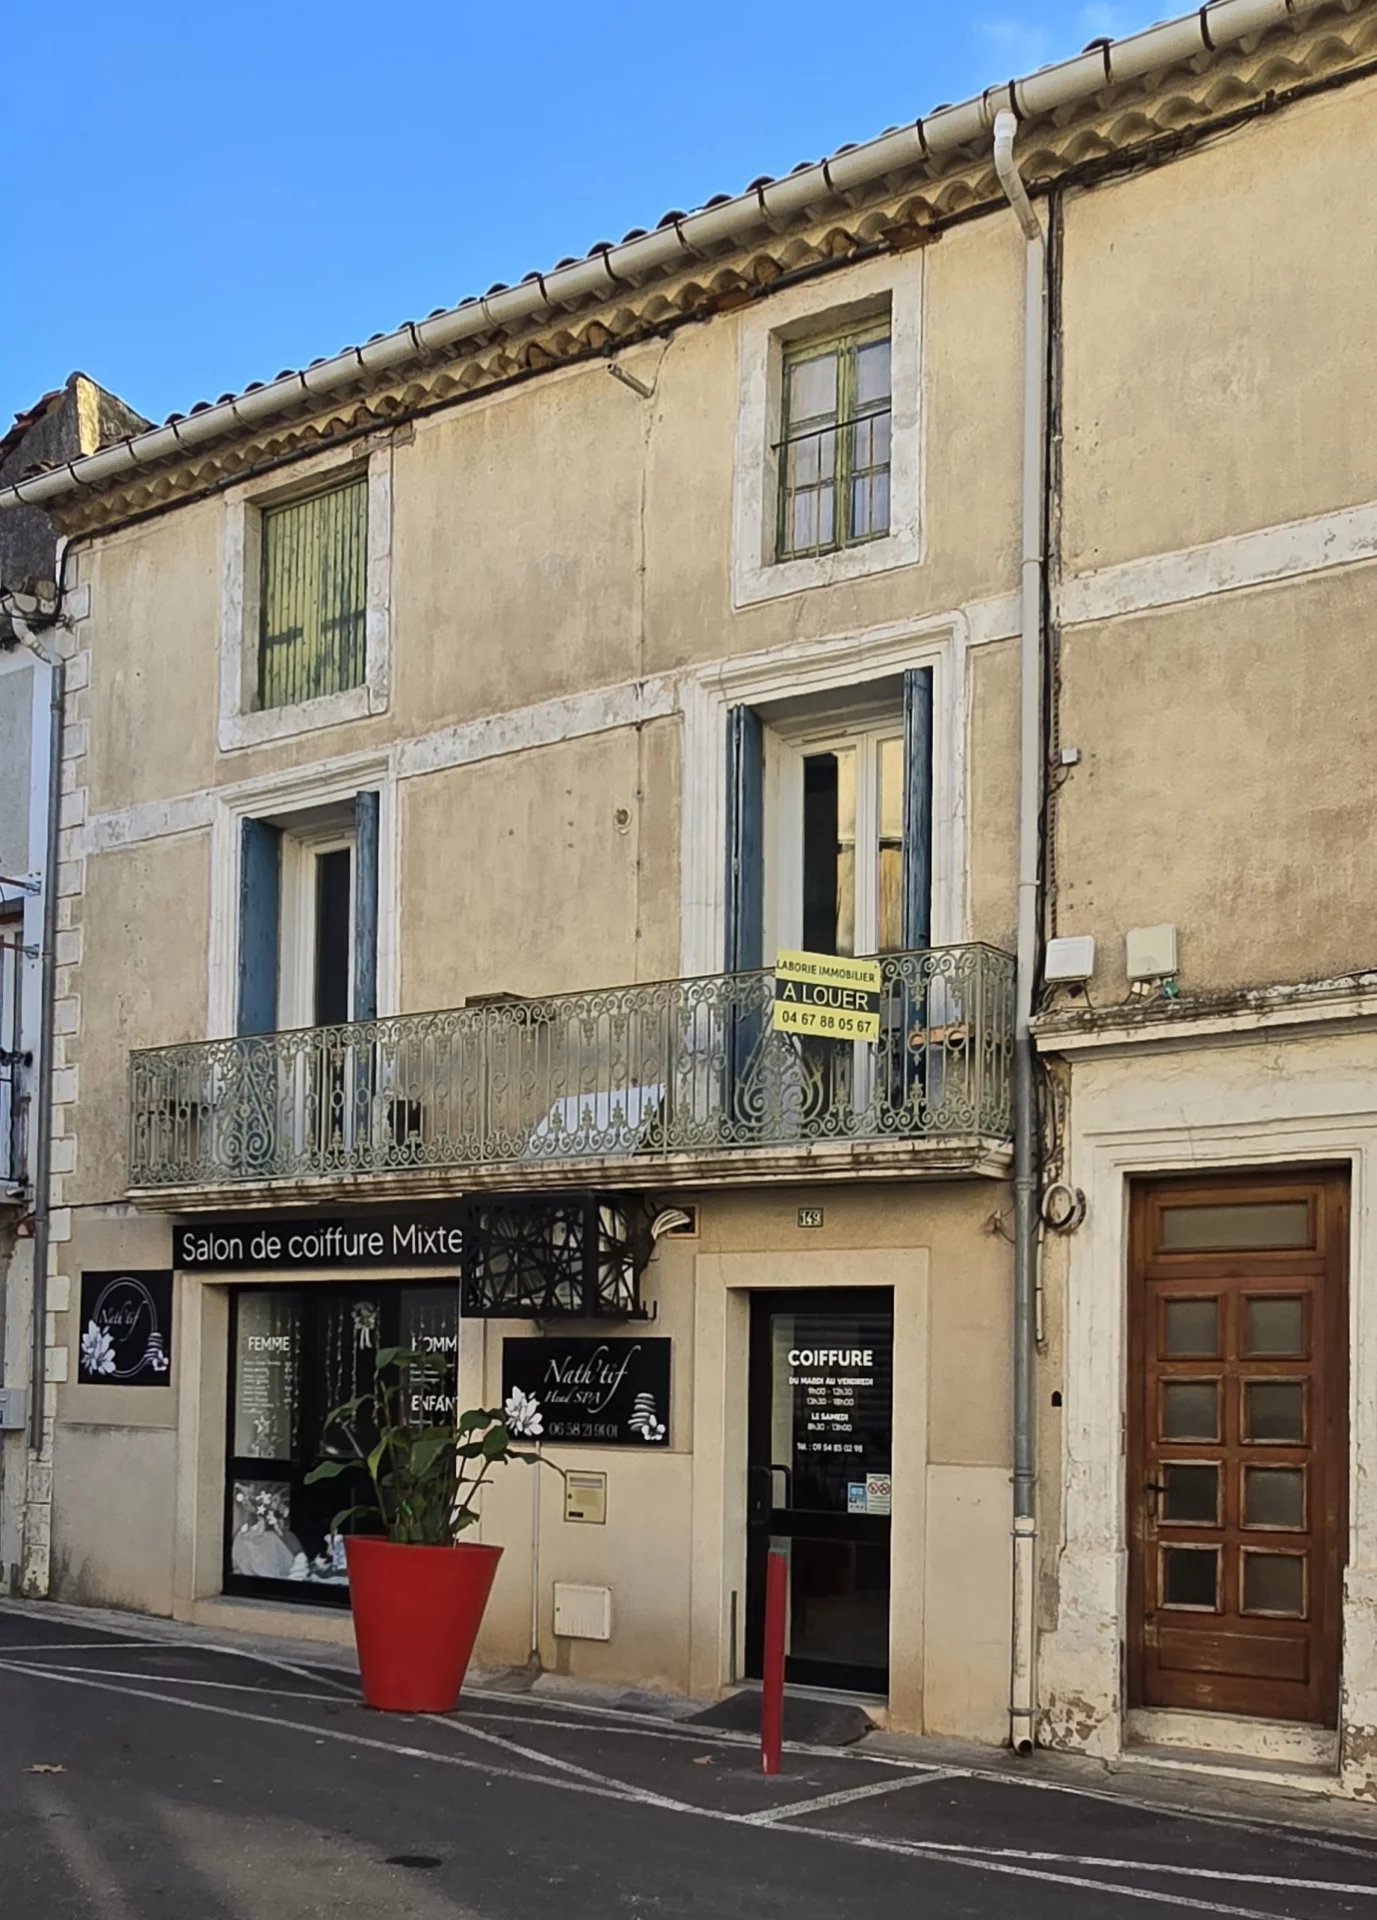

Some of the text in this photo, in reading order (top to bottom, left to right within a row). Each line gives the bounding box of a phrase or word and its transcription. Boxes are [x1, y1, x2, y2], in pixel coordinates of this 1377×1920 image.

[777, 960, 875, 982] LABORIE IMMOBILIER
[783, 982, 869, 1010] A LOUER
[782, 1010, 871, 1033] 04 67 88 05 67
[800, 1210, 821, 1225] 149
[182, 1224, 463, 1261] Salon de coiffure Mixte
[248, 1336, 290, 1351] FEMME
[788, 1350, 873, 1366] COIFFURE
[544, 1345, 641, 1414] Nath'tif
[789, 1376, 873, 1386] DU MARDI AU VENDREDI
[411, 1395, 458, 1411] ENFAN
[544, 1386, 601, 1404] Head SPA
[811, 1412, 848, 1421] LE SAMEDI
[549, 1422, 564, 1436] 06
[566, 1422, 581, 1436] 58
